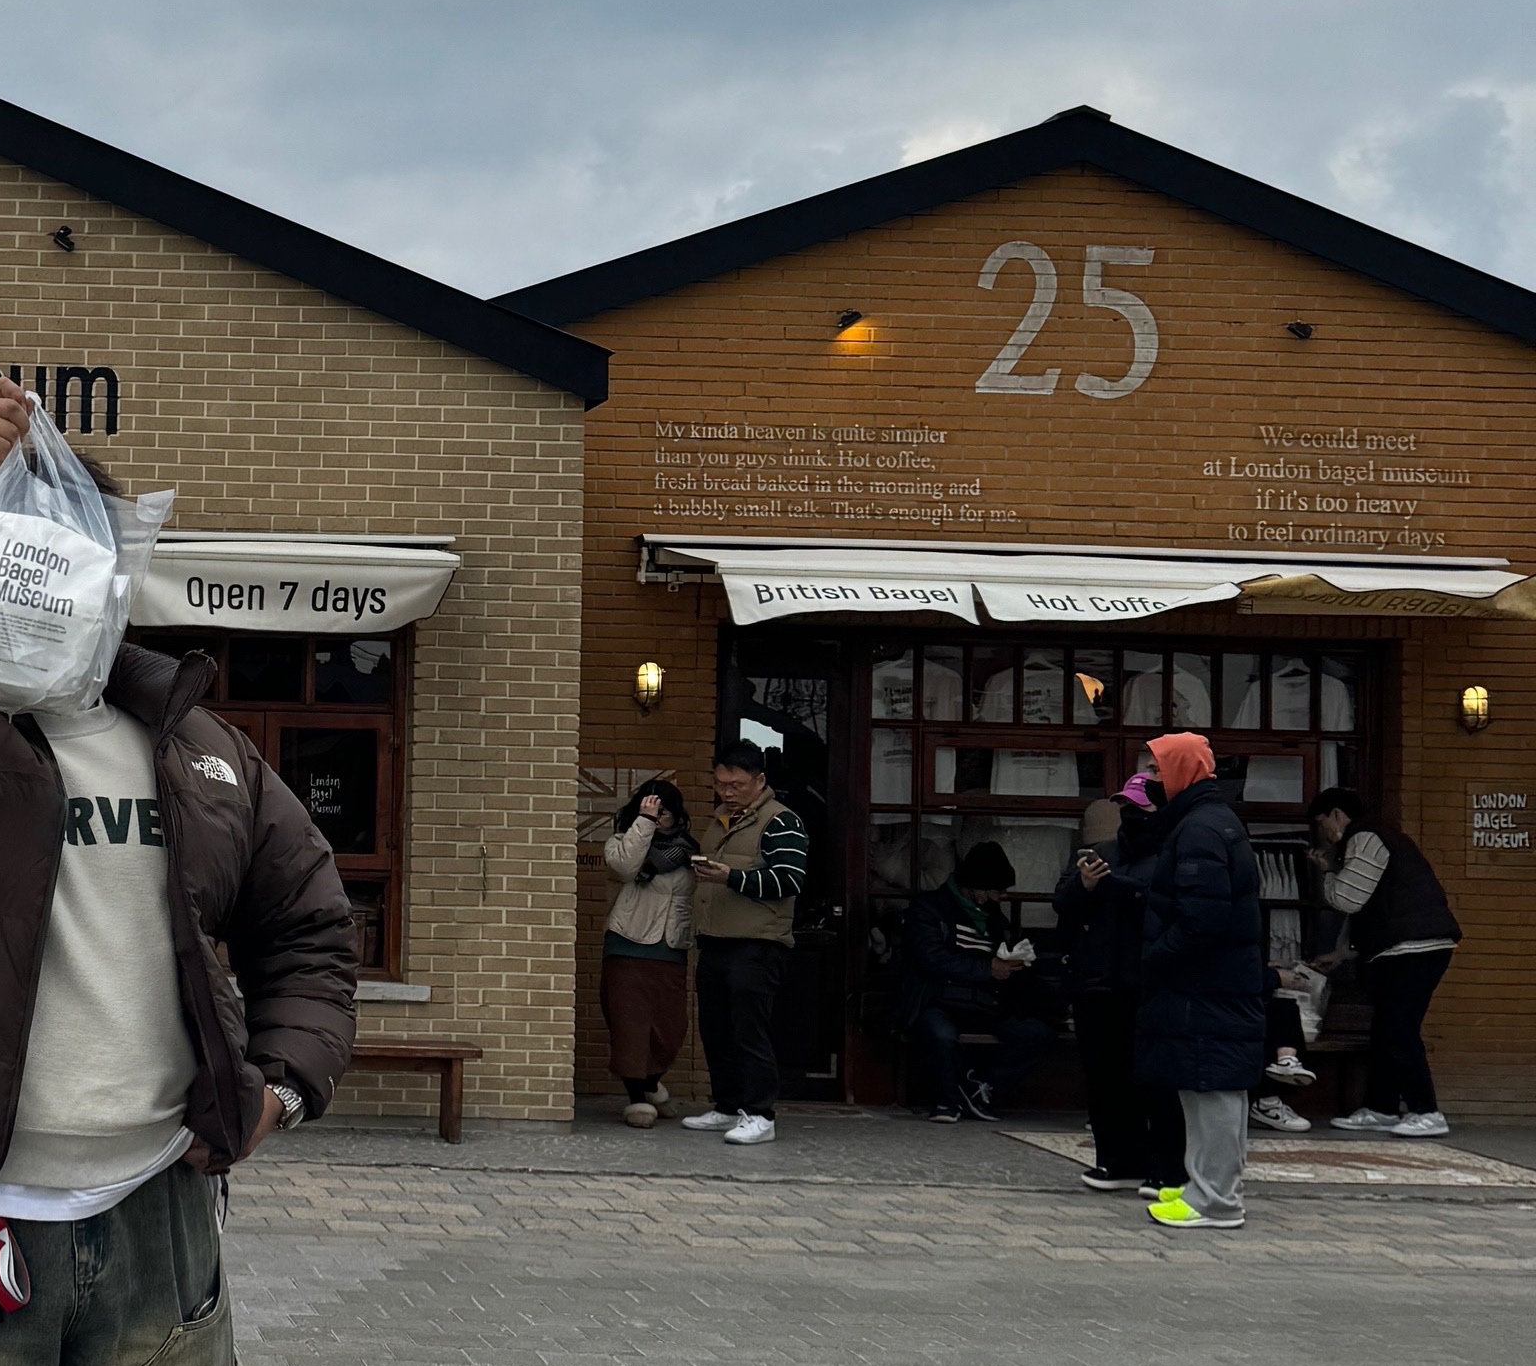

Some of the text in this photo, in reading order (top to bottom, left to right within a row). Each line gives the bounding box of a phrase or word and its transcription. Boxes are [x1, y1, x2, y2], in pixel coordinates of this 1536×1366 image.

[975, 240, 1159, 400] 25
[655, 420, 947, 447] My kinda heaven is quite simpler
[1259, 425, 1417, 451] We could meet
[654, 446, 936, 470] than you guys think. Hot coffee,
[1203, 456, 1472, 485] at London bagel museum
[654, 473, 981, 499] fresh bread baked in the morning and
[653, 498, 1021, 525] a bubbly small talk. That's enough for me.
[1256, 488, 1418, 519] if it's too heavy
[1227, 521, 1445, 552] to feel ordinary days
[2, 539, 70, 576] London
[186, 576, 387, 621] Open 7 days
[753, 583, 958, 605] British Bagel
[1026, 594, 1168, 613] Hot Coffe
[310, 773, 340, 789] London
[311, 788, 332, 802] Bagel
[1472, 793, 1527, 808] LONDON
[1473, 813, 1517, 830] BAGEL
[1472, 831, 1530, 848] MUSEUM
[576, 853, 602, 866] ndon
